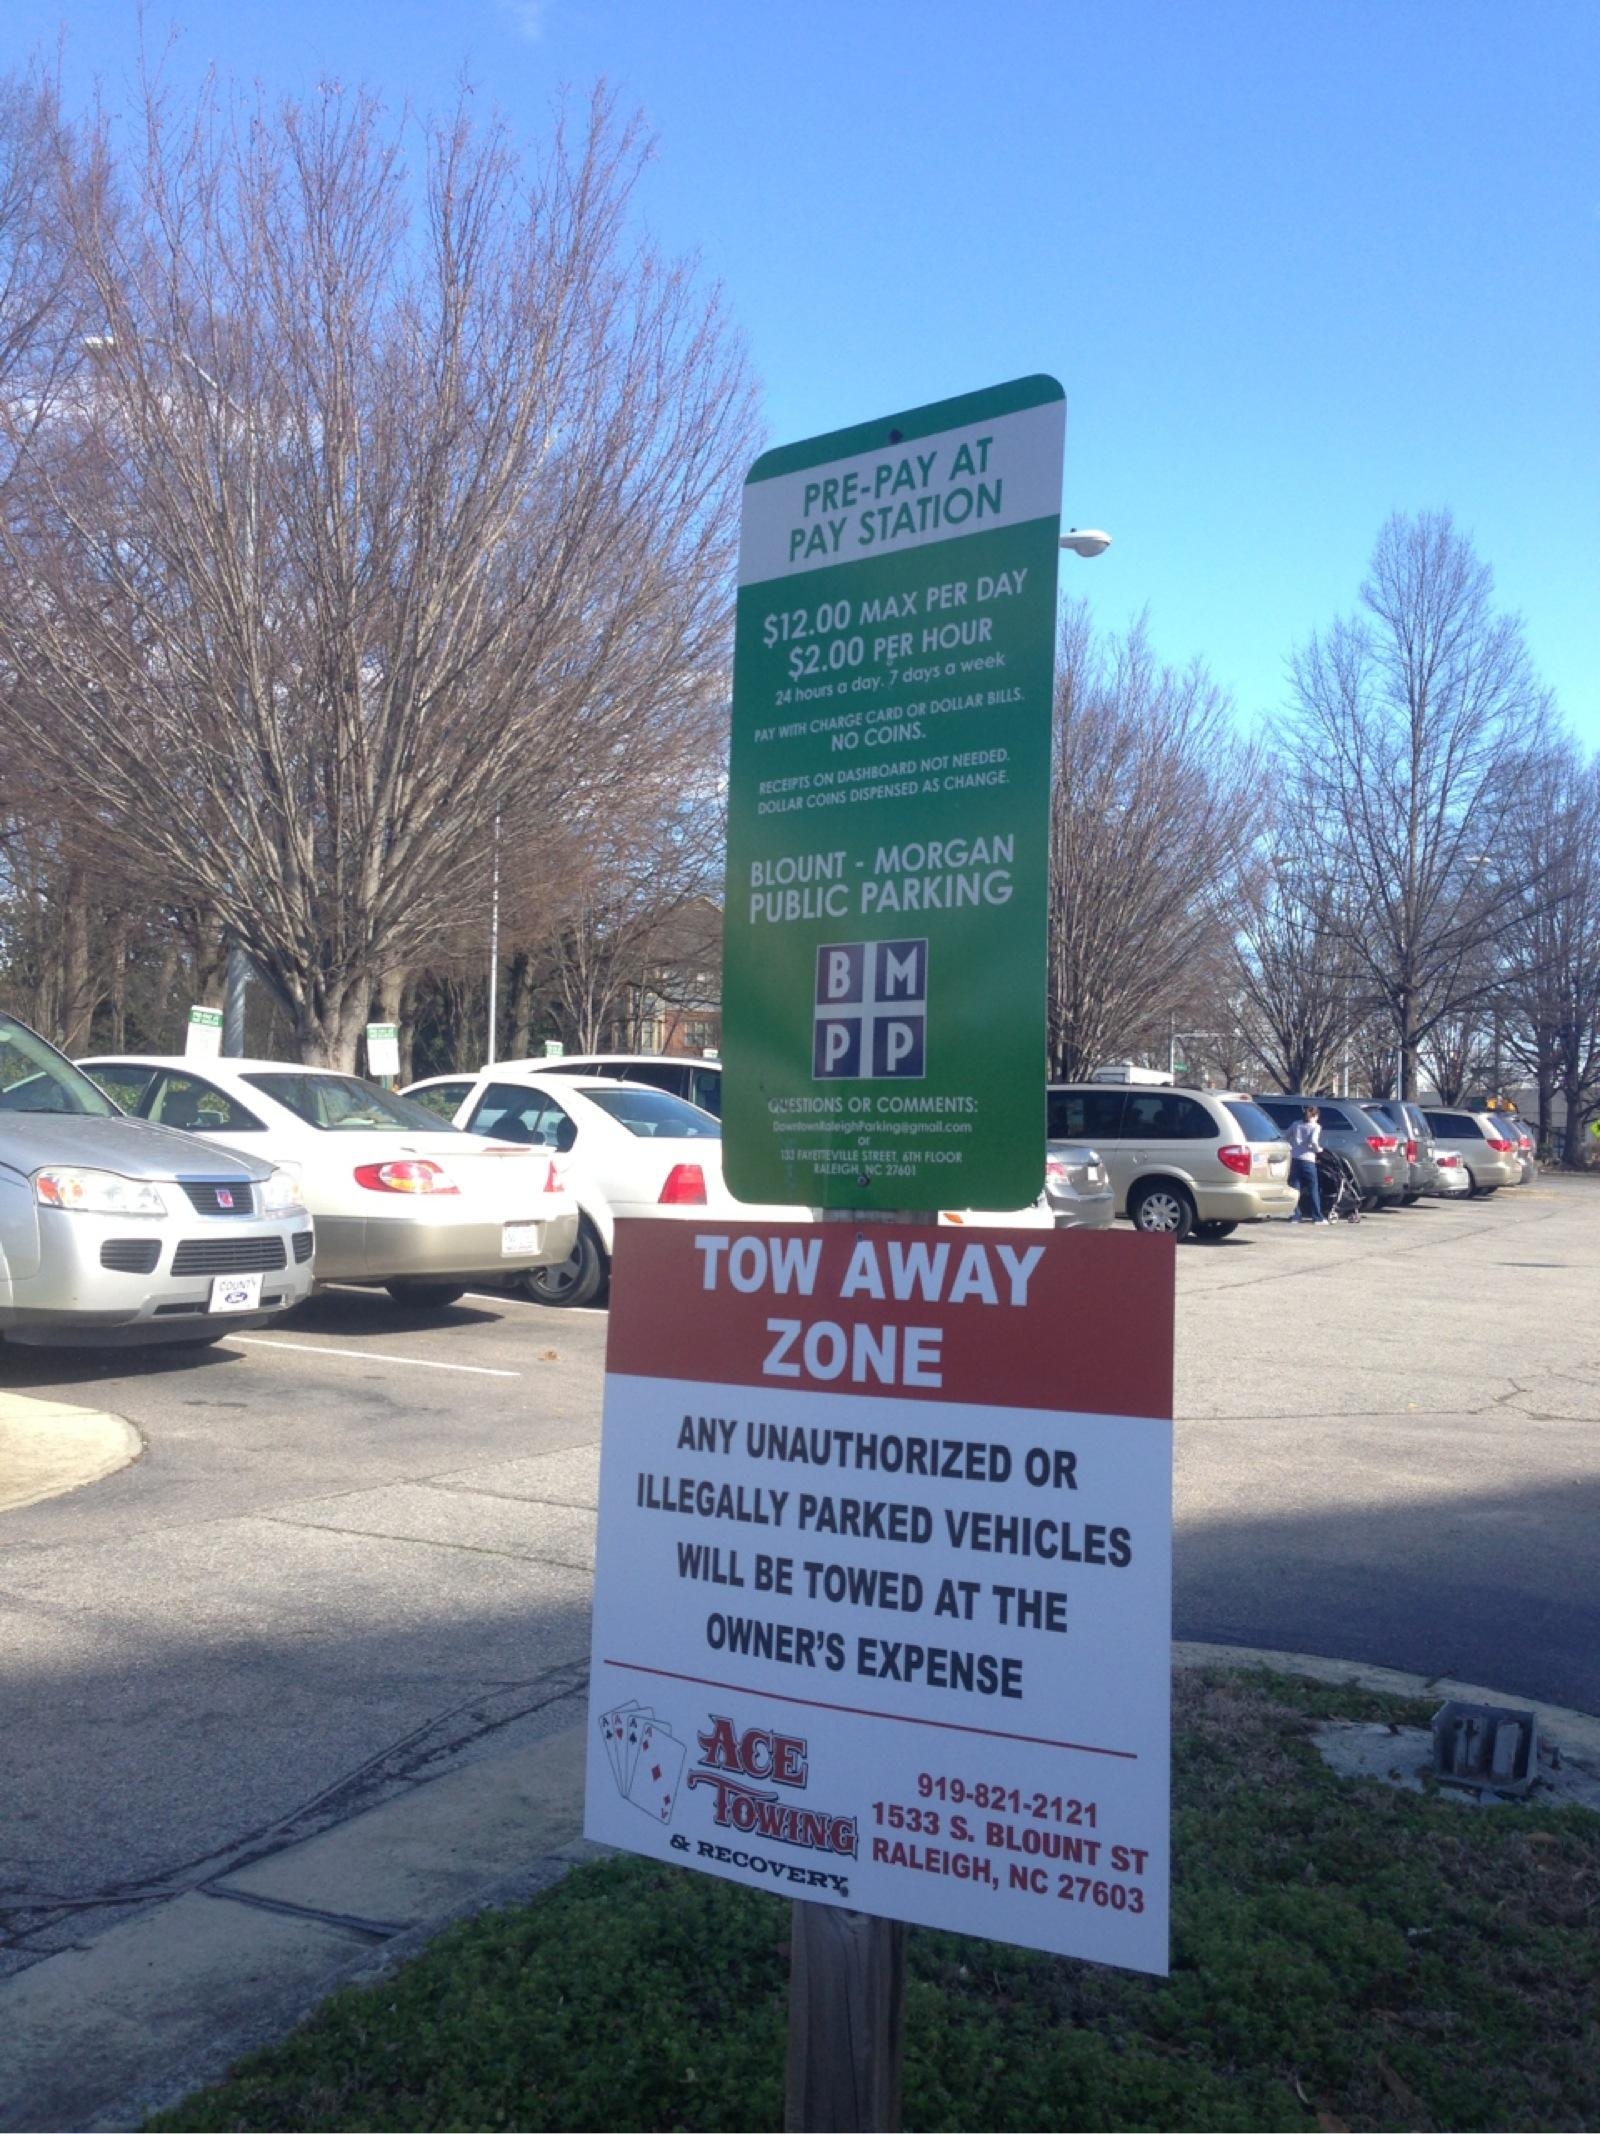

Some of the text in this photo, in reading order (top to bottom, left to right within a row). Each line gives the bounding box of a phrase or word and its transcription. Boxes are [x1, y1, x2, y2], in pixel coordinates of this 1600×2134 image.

[803, 437, 993, 517] PRE-PAY AT
[789, 479, 1002, 562] PAY STATION
[763, 568, 1028, 648] $12.00 MAX PER DAY
[775, 689, 791, 706] 24
[795, 683, 834, 702] hours
[837, 683, 848, 694] a
[889, 669, 898, 686] 7
[902, 663, 940, 685] days
[944, 664, 955, 675] a
[960, 651, 1006, 671] week
[788, 617, 993, 682] $2.00 PER HOUR
[754, 727, 775, 743] PAY
[777, 722, 806, 739] WITH
[809, 712, 863, 733] CHARGE
[865, 706, 903, 724] CARD
[906, 702, 927, 718] OR
[930, 694, 984, 715] DOLLAR
[831, 722, 927, 752] NO COINS.
[757, 796, 803, 815] DOLLAR
[806, 790, 846, 808] COINS
[850, 781, 918, 803] DISPENSED
[922, 777, 940, 793] AS
[759, 773, 810, 796] RECEIPTS
[814, 772, 834, 787] ON
[837, 760, 916, 785] DASHBOARD
[920, 754, 949, 772] NOT
[750, 852, 846, 887] BLOUNT
[874, 834, 1014, 875] MORGAN
[750, 870, 1013, 925] PUBLIC PARKING
[828, 946, 917, 998] B M
[824, 1022, 914, 1072] P P
[768, 1096, 978, 1113] QUESTIONS OR COMMENTS:
[858, 1136, 870, 1146] or
[925, 1151, 962, 1163] FLOOR
[695, 1234, 1046, 1307] TOW AWAY
[762, 1318, 943, 1388] ZONE
[677, 1416, 1077, 1490] ANY UNAUTHORIZED OR
[637, 1473, 1132, 1568] ILLEGALLY PARKED VEHICLES
[677, 1542, 1068, 1633] WILL BE TOWED AT THE
[706, 1613, 1023, 1699] OWNER'S EXPENSE
[697, 1713, 808, 1789] ACE
[687, 1768, 859, 1862] TOWING
[917, 1773, 1097, 1828] 919-821-2121
[670, 1834, 848, 1891] & RECOVERY
[872, 1802, 1149, 1875] 1533 S. BLOUNT ST
[872, 1838, 1144, 1915] RALEIGH, NC 27603
